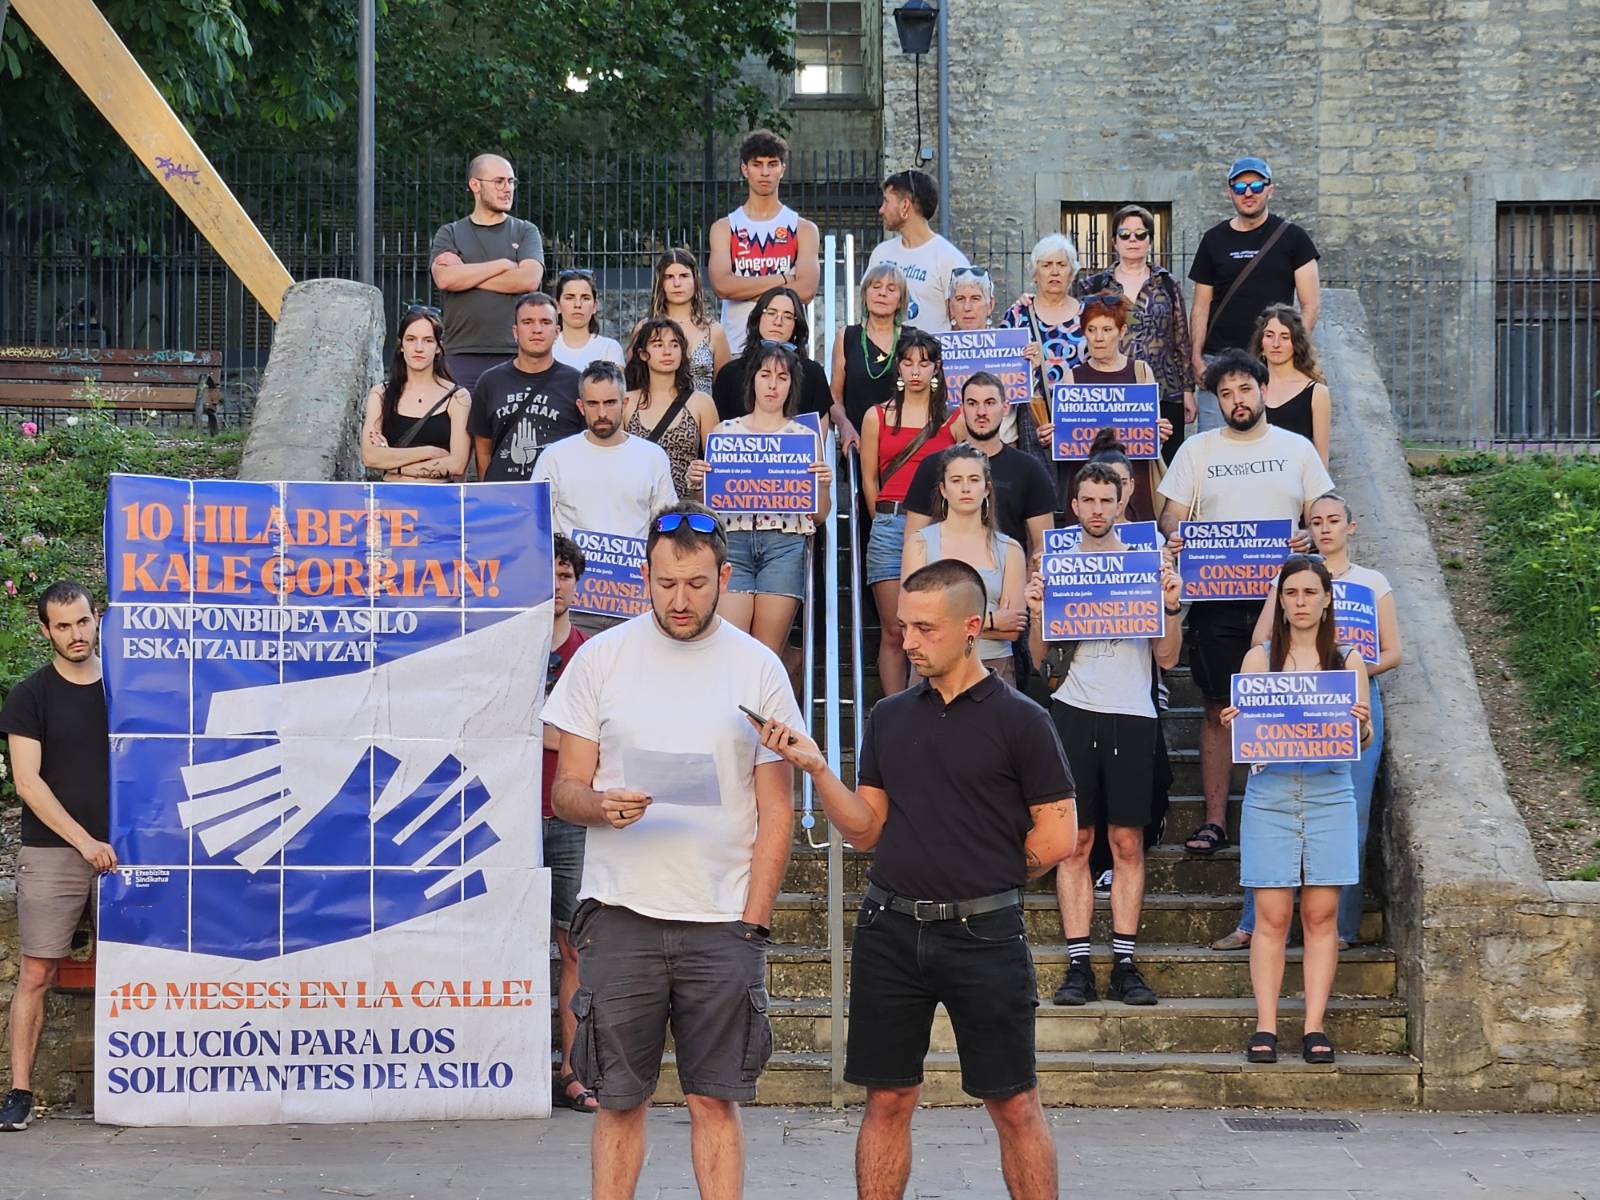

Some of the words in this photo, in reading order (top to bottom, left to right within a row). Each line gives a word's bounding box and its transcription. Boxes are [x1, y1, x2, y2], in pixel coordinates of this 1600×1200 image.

[935, 333, 996, 349] SASUN
[941, 347, 1025, 360] OLKULARITZAK
[1057, 388, 1125, 402] OSASUN
[1057, 402, 1154, 412] AHOLKULARITZAK
[1072, 427, 1154, 441] COEJOS
[710, 437, 782, 452] OSASUN
[710, 453, 812, 464] AHOLKULARITZAK
[1207, 464, 1233, 479] SEX
[1250, 459, 1288, 474] CITY
[725, 479, 813, 494] CONSEJOS
[711, 494, 813, 509] SANITARIOS
[121, 502, 173, 541] 10
[183, 504, 419, 547] HILABETE
[1184, 523, 1258, 538] OSASUN
[575, 533, 648, 557] OSASUN
[1184, 538, 1287, 548] AHOLKULARITZAK
[1047, 556, 1124, 573] OSASUN
[121, 553, 253, 594] KALE
[260, 558, 501, 599] GORRIAN!
[1047, 573, 1157, 586] AHOLKULARITZAK
[584, 577, 650, 600] CONSEJ
[1064, 601, 1158, 617] CONSEJOS
[122, 607, 331, 633] KONPONBIDEA
[334, 611, 418, 634] ASILO
[1050, 618, 1158, 635] SANITARIOS
[122, 638, 378, 662] ESKATZAILEENTZAT
[1237, 676, 1318, 693] OSASUN
[1238, 693, 1352, 706] AHOLKULARITZAK
[1255, 722, 1354, 740] CONSEJOS
[1240, 740, 1354, 759] SANITARIOS
[108, 982, 158, 1018] ¡10
[165, 981, 290, 1010] MESES
[299, 981, 349, 1009] EN
[357, 981, 405, 1009] LA
[411, 979, 534, 1008] CALLE!
[108, 1022, 281, 1058] SOLUCIÓN
[290, 1028, 383, 1055] PARA
[391, 1027, 456, 1054] LOS
[108, 1063, 355, 1094] SOLICITANTES
[364, 1062, 407, 1090] DE
[414, 1062, 514, 1090] ASILO
